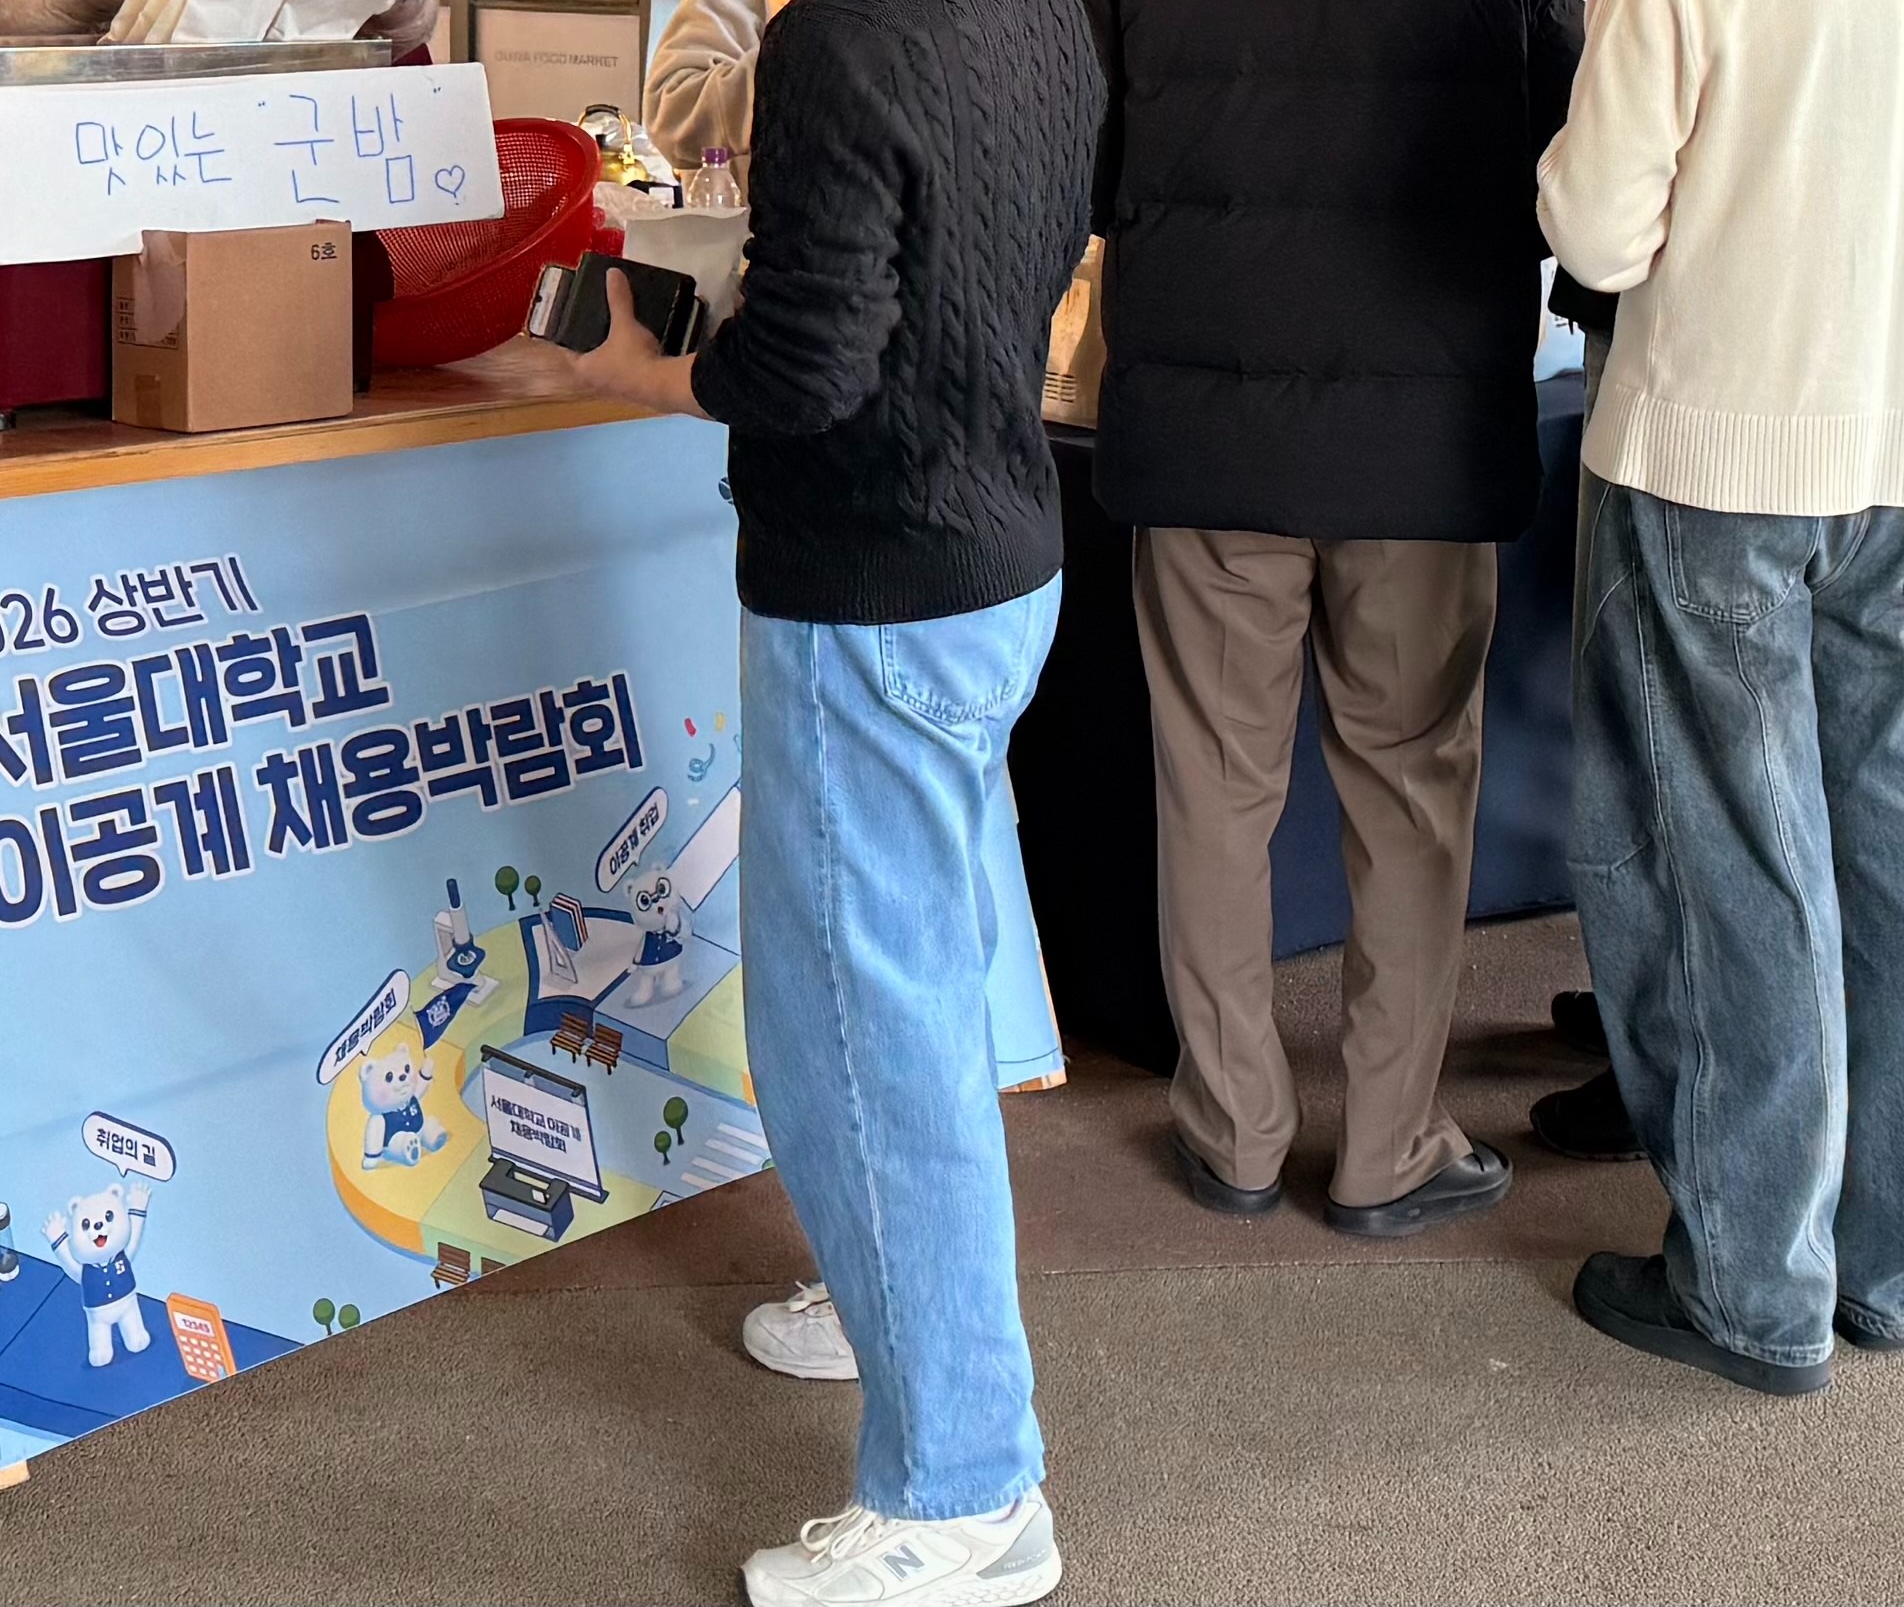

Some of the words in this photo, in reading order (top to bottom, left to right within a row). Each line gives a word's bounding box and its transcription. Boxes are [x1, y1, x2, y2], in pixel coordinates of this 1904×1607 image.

[75, 110, 234, 197] 맛있는
[310, 242, 339, 261] 6호
[86, 555, 260, 637] 상반기
[255, 672, 645, 857] 채용박람회
[96, 1127, 138, 1161] 취업의
